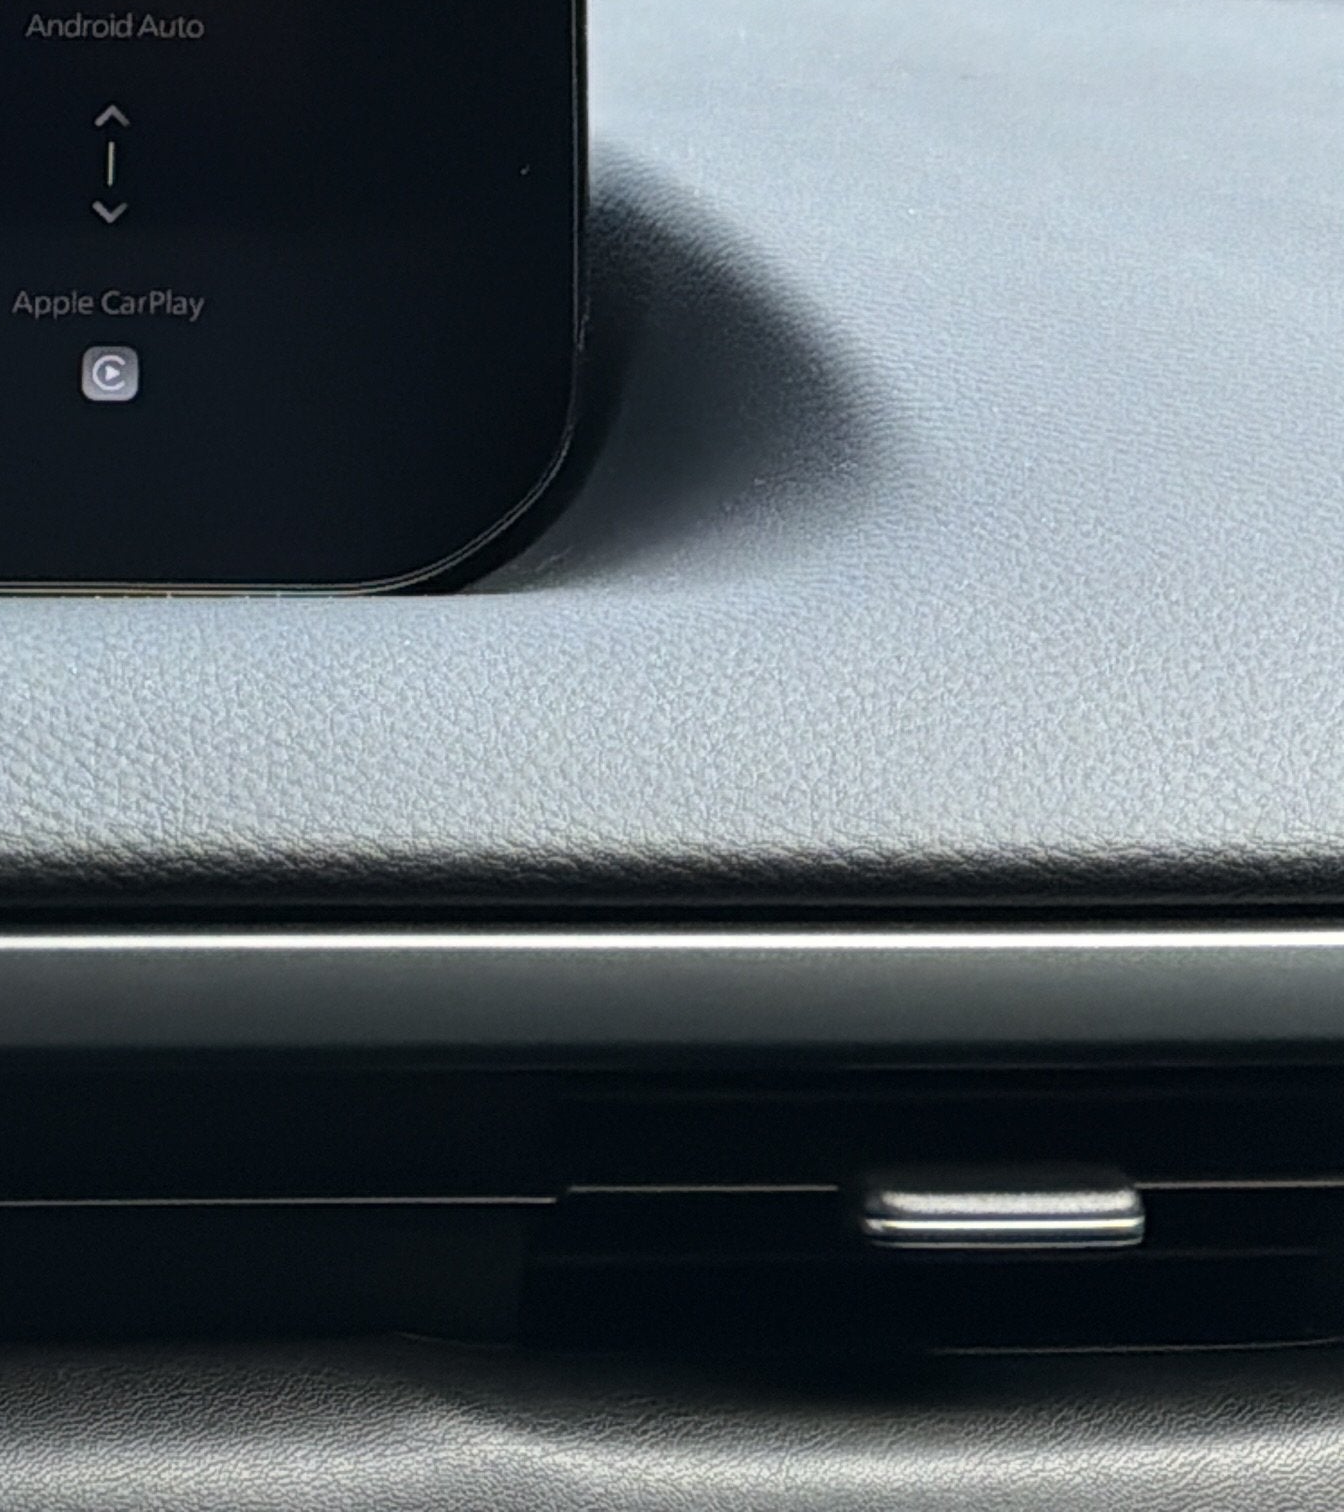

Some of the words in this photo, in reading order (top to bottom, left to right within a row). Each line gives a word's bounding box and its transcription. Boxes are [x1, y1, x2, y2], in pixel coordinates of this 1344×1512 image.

[25, 12, 134, 39] Android
[136, 13, 205, 40] Auto
[11, 290, 95, 321] Apple
[101, 289, 206, 323] CarPlay
